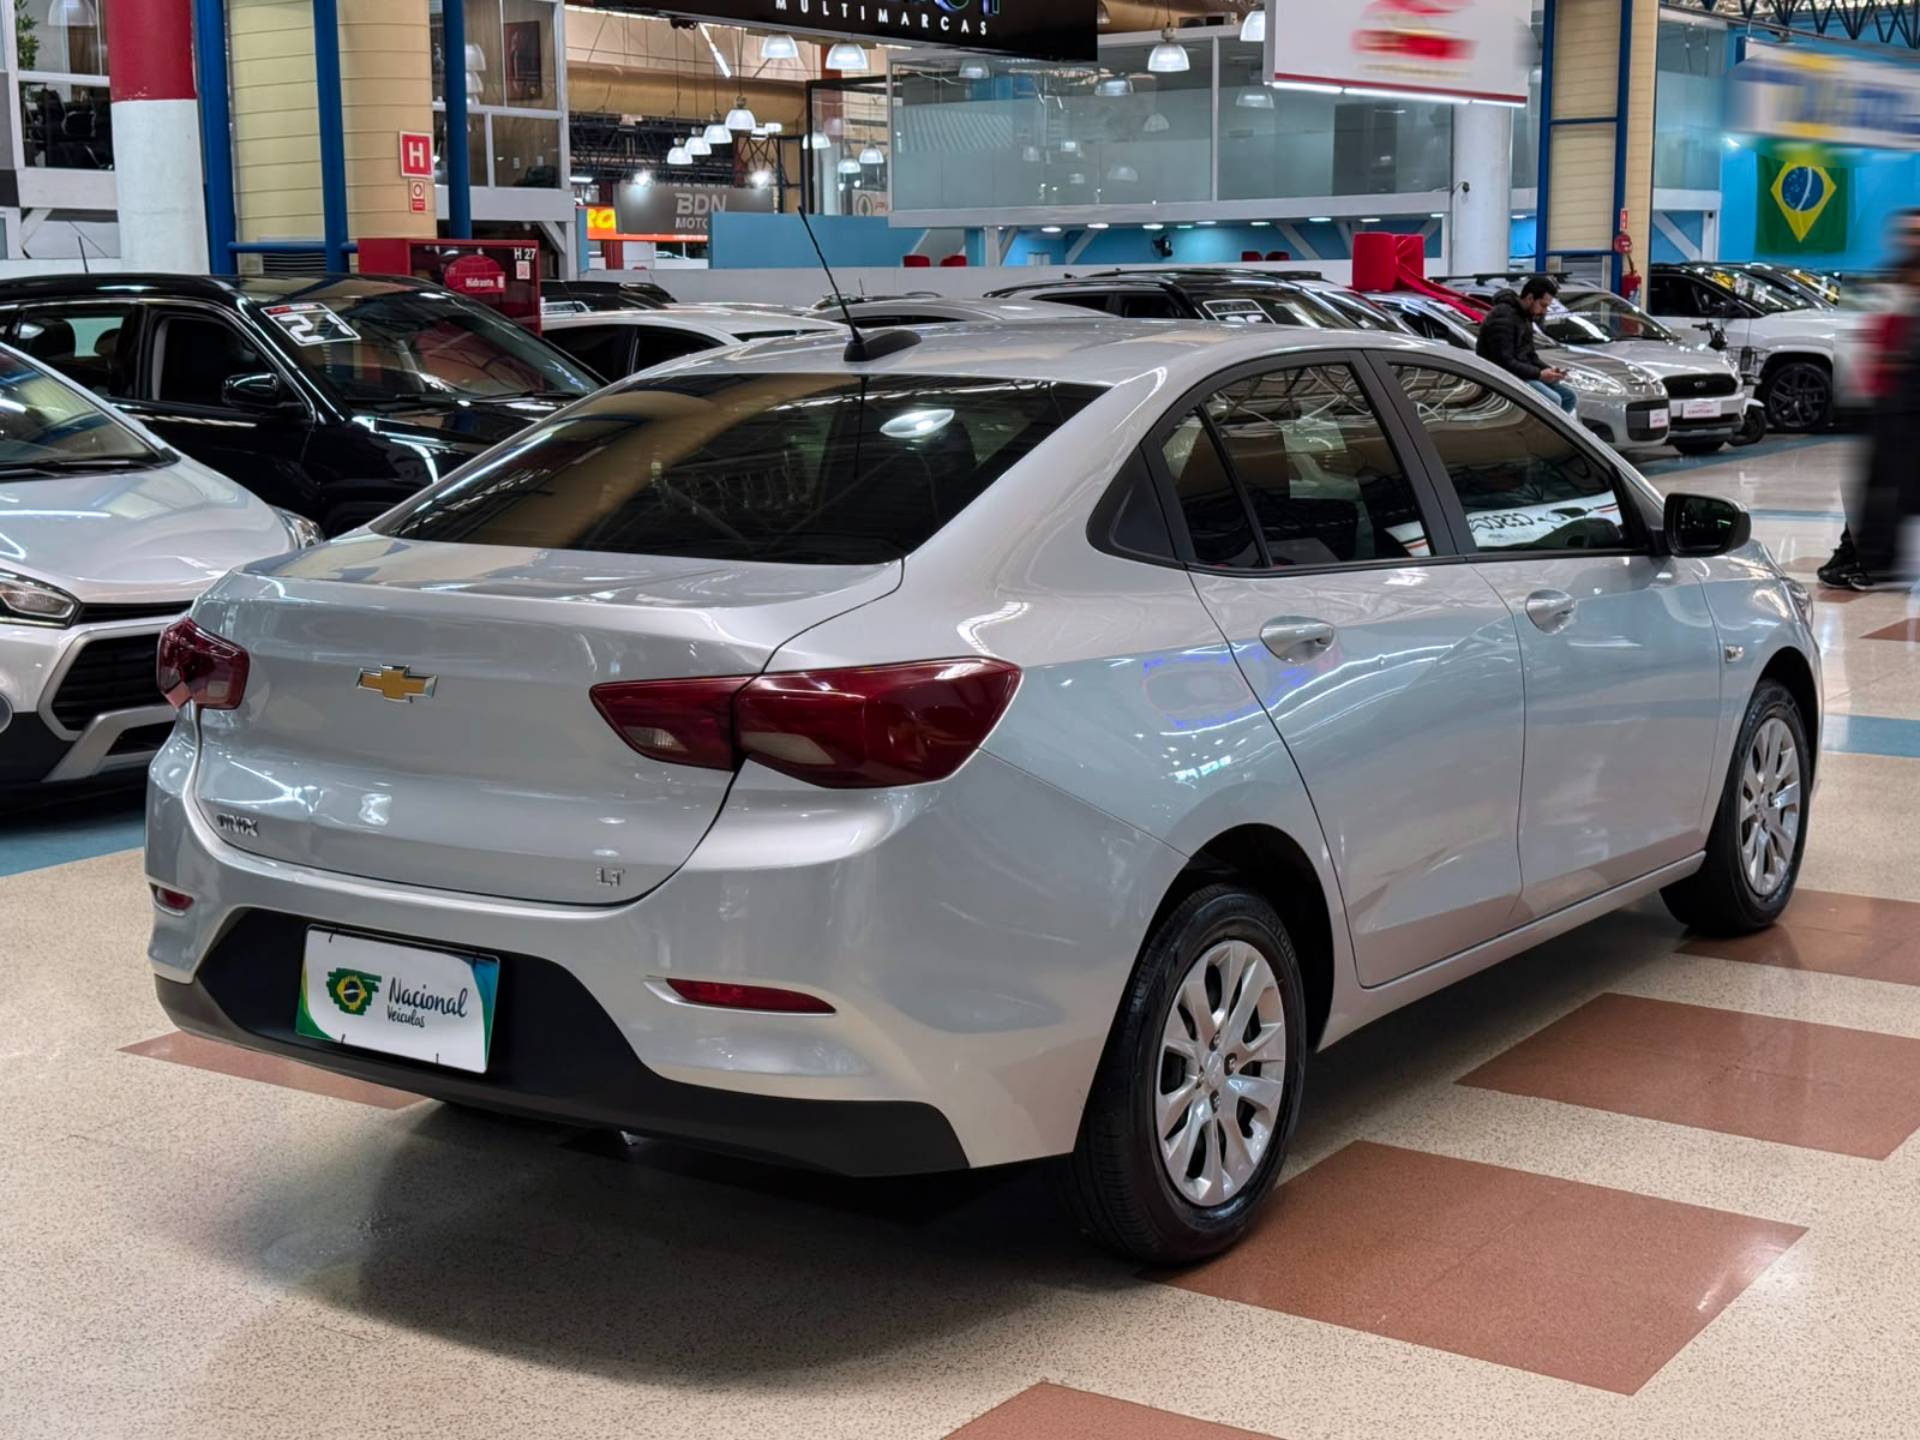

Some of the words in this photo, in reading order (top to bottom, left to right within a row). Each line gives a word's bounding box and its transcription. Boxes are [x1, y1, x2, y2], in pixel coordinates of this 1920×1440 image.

[776, 0, 987, 35] MULTIMARCAS
[408, 141, 425, 168] H
[674, 192, 727, 215] BDN
[514, 248, 522, 260] H
[524, 248, 536, 260] 27
[388, 976, 468, 1018] Nacional
